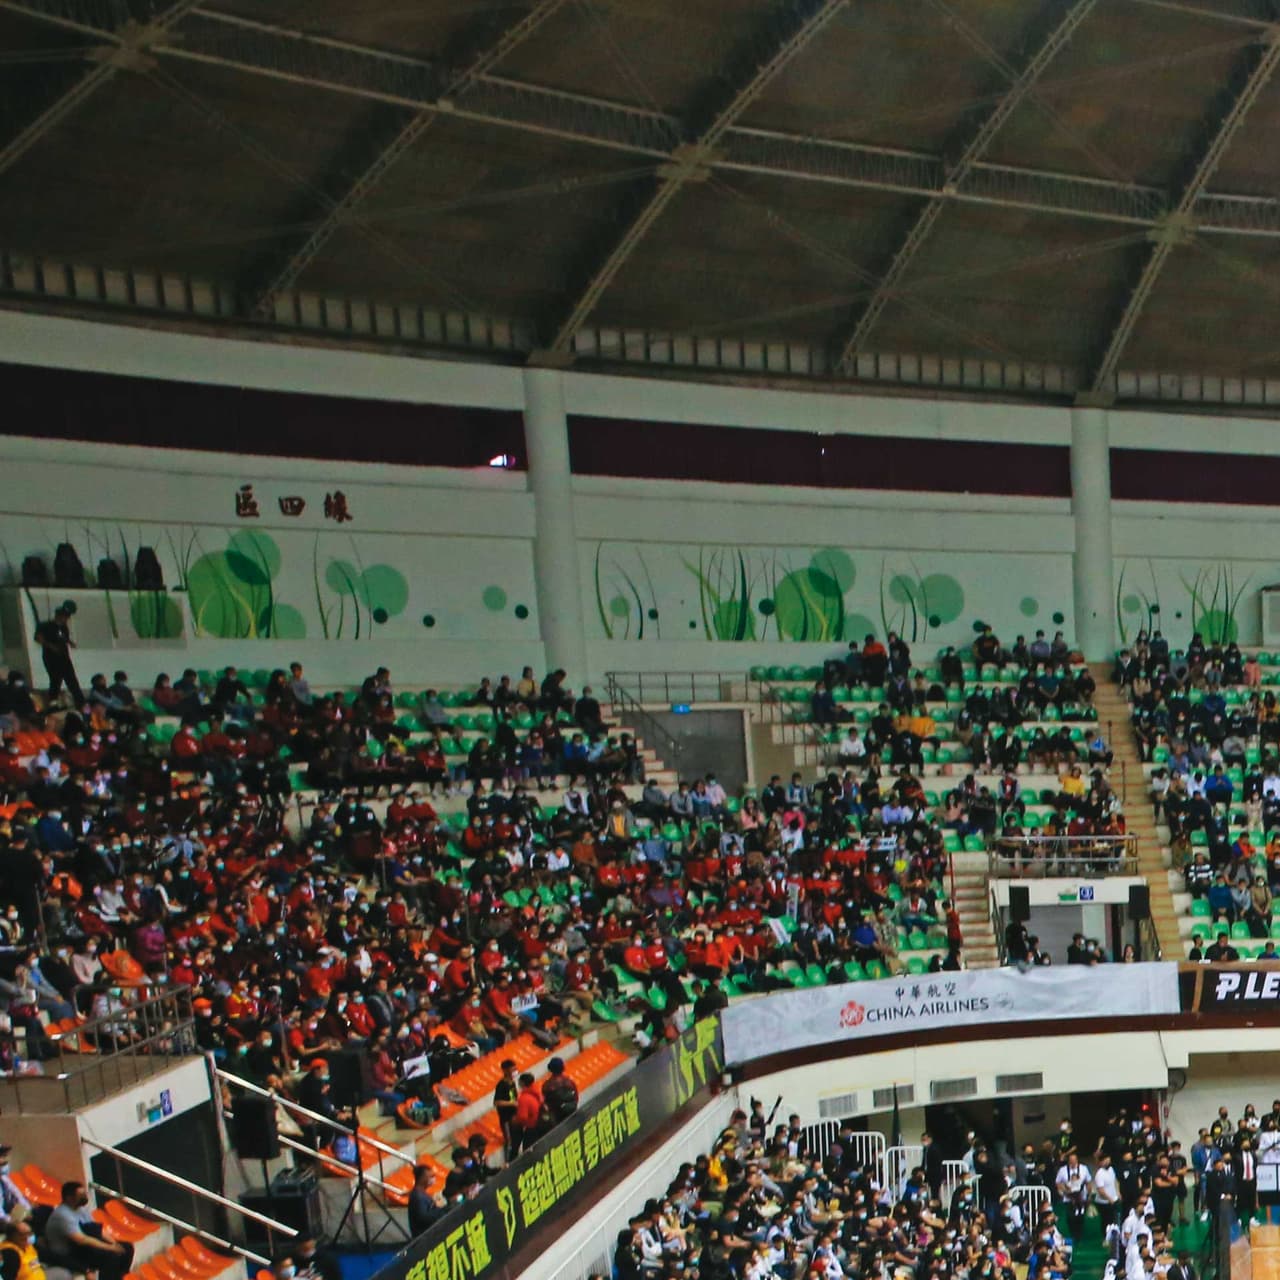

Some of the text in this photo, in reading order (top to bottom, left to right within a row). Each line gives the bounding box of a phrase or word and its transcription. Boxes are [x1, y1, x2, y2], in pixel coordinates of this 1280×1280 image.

[895, 981, 957, 1001] 中華航空
[866, 1005, 916, 1023] CHINA
[919, 998, 989, 1018] AIRLINES
[517, 1085, 641, 1228] 超越無限 夢想不滅
